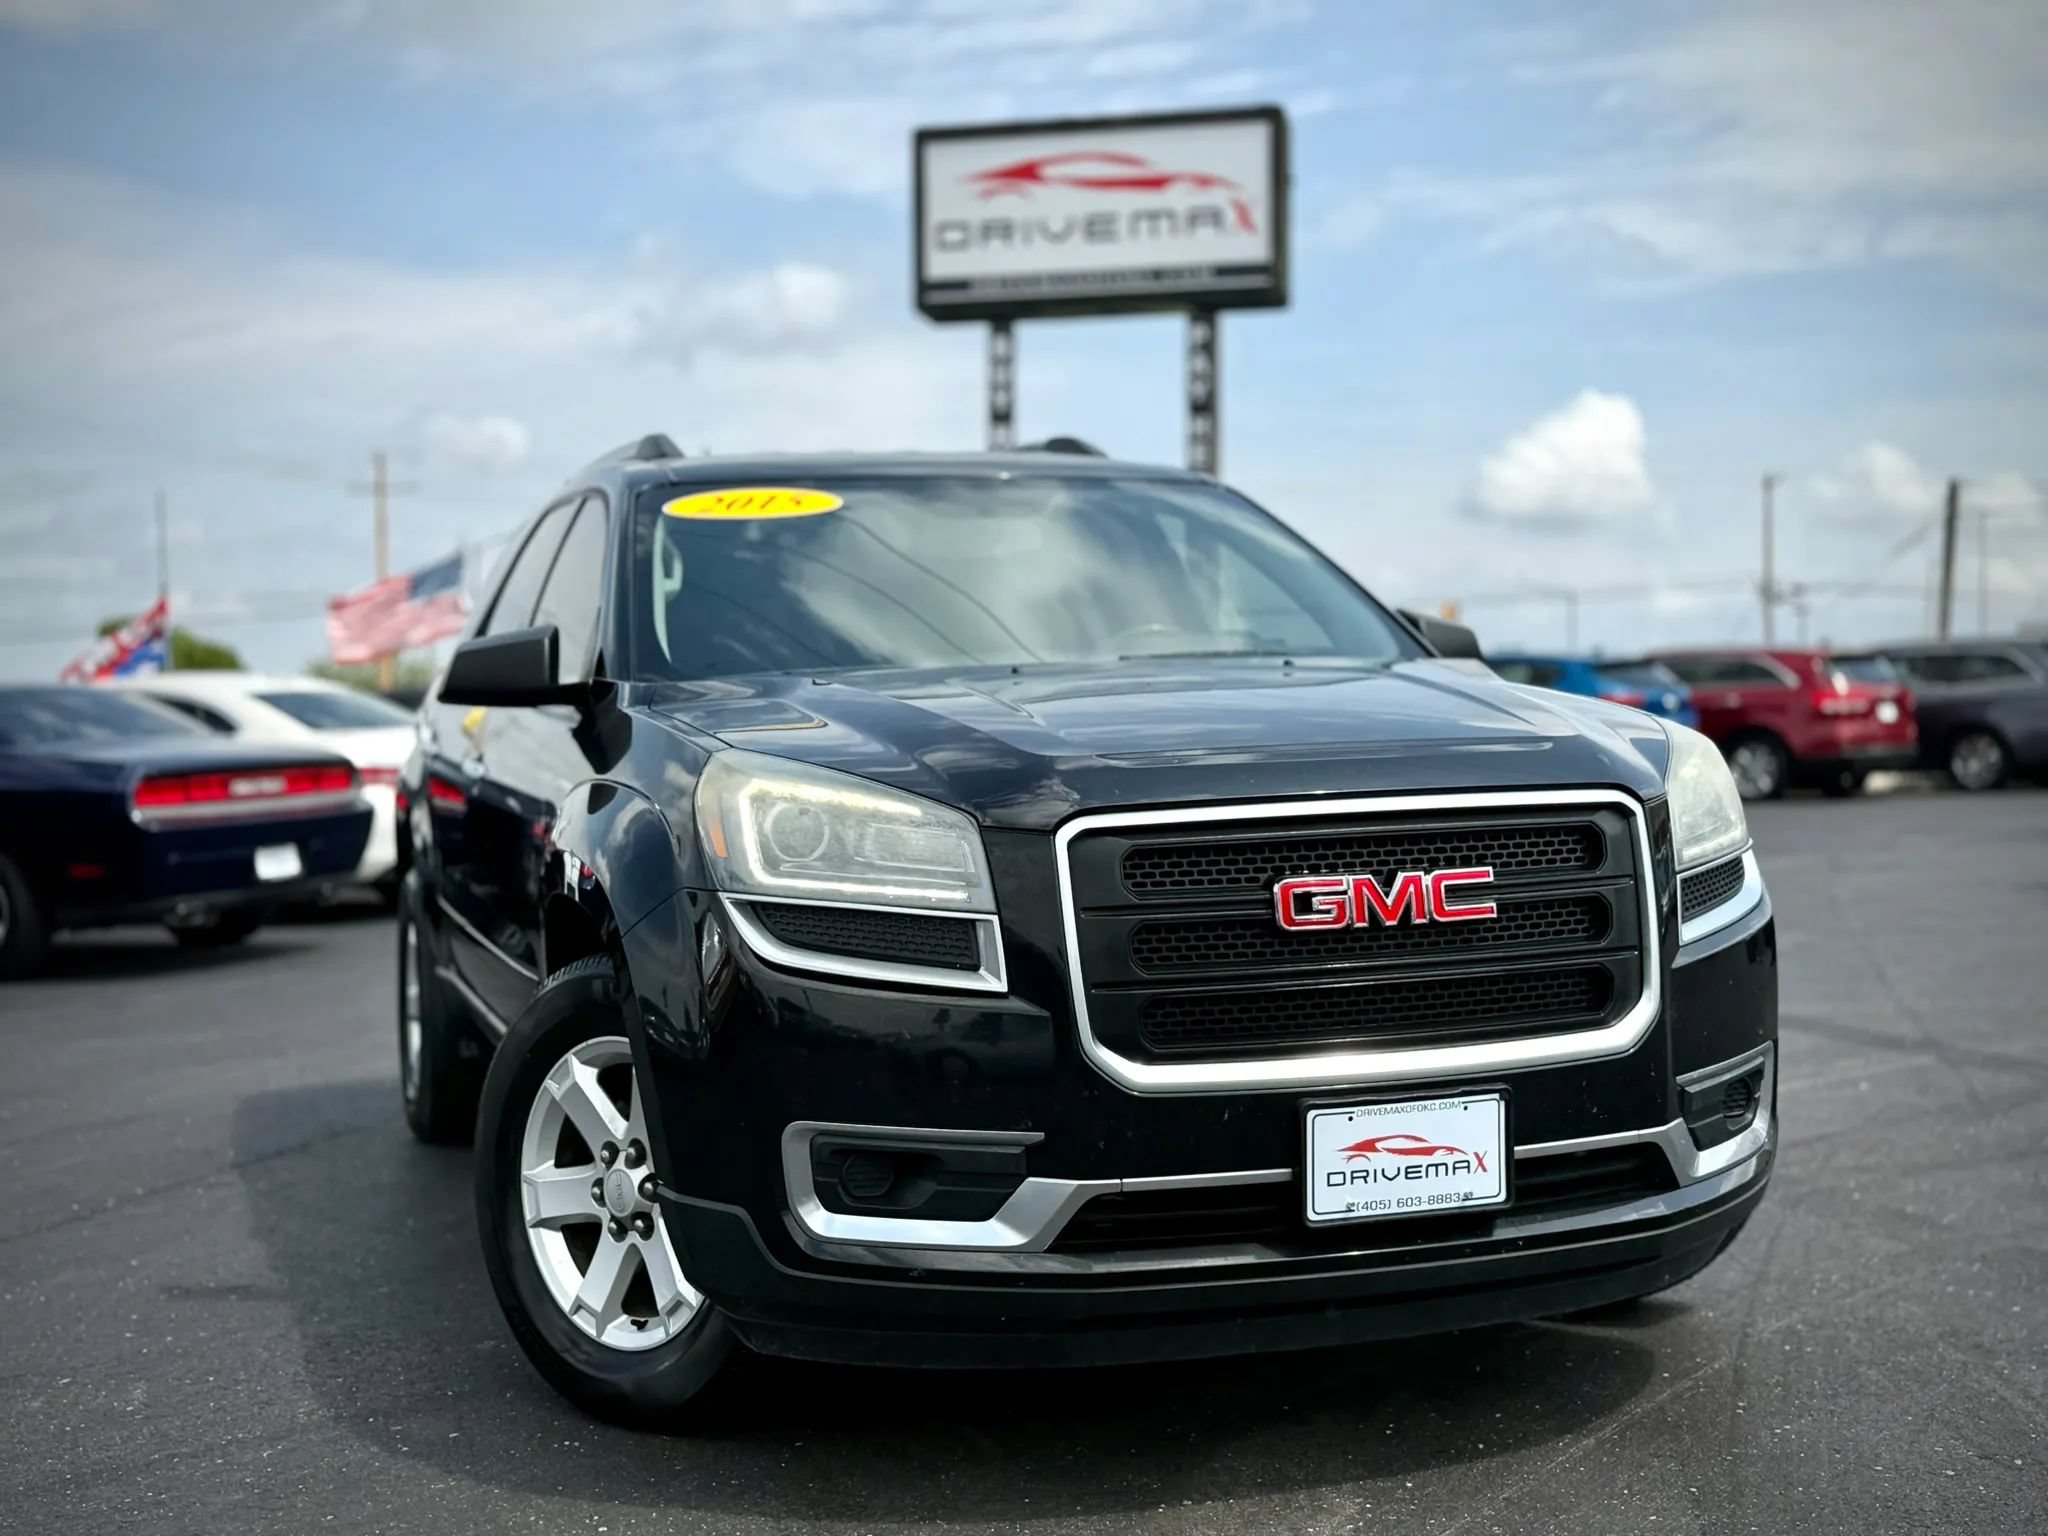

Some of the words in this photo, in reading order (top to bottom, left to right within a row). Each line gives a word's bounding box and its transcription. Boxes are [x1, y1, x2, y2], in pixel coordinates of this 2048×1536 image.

[1273, 866, 1497, 931] GMC
[1356, 1101, 1461, 1117] DRIVEMAXOFOKC.COM
[1327, 1150, 1488, 1187] DRIVEMAX
[1356, 1200, 1391, 1212] (405)
[1396, 1192, 1460, 1208] 603-8883
